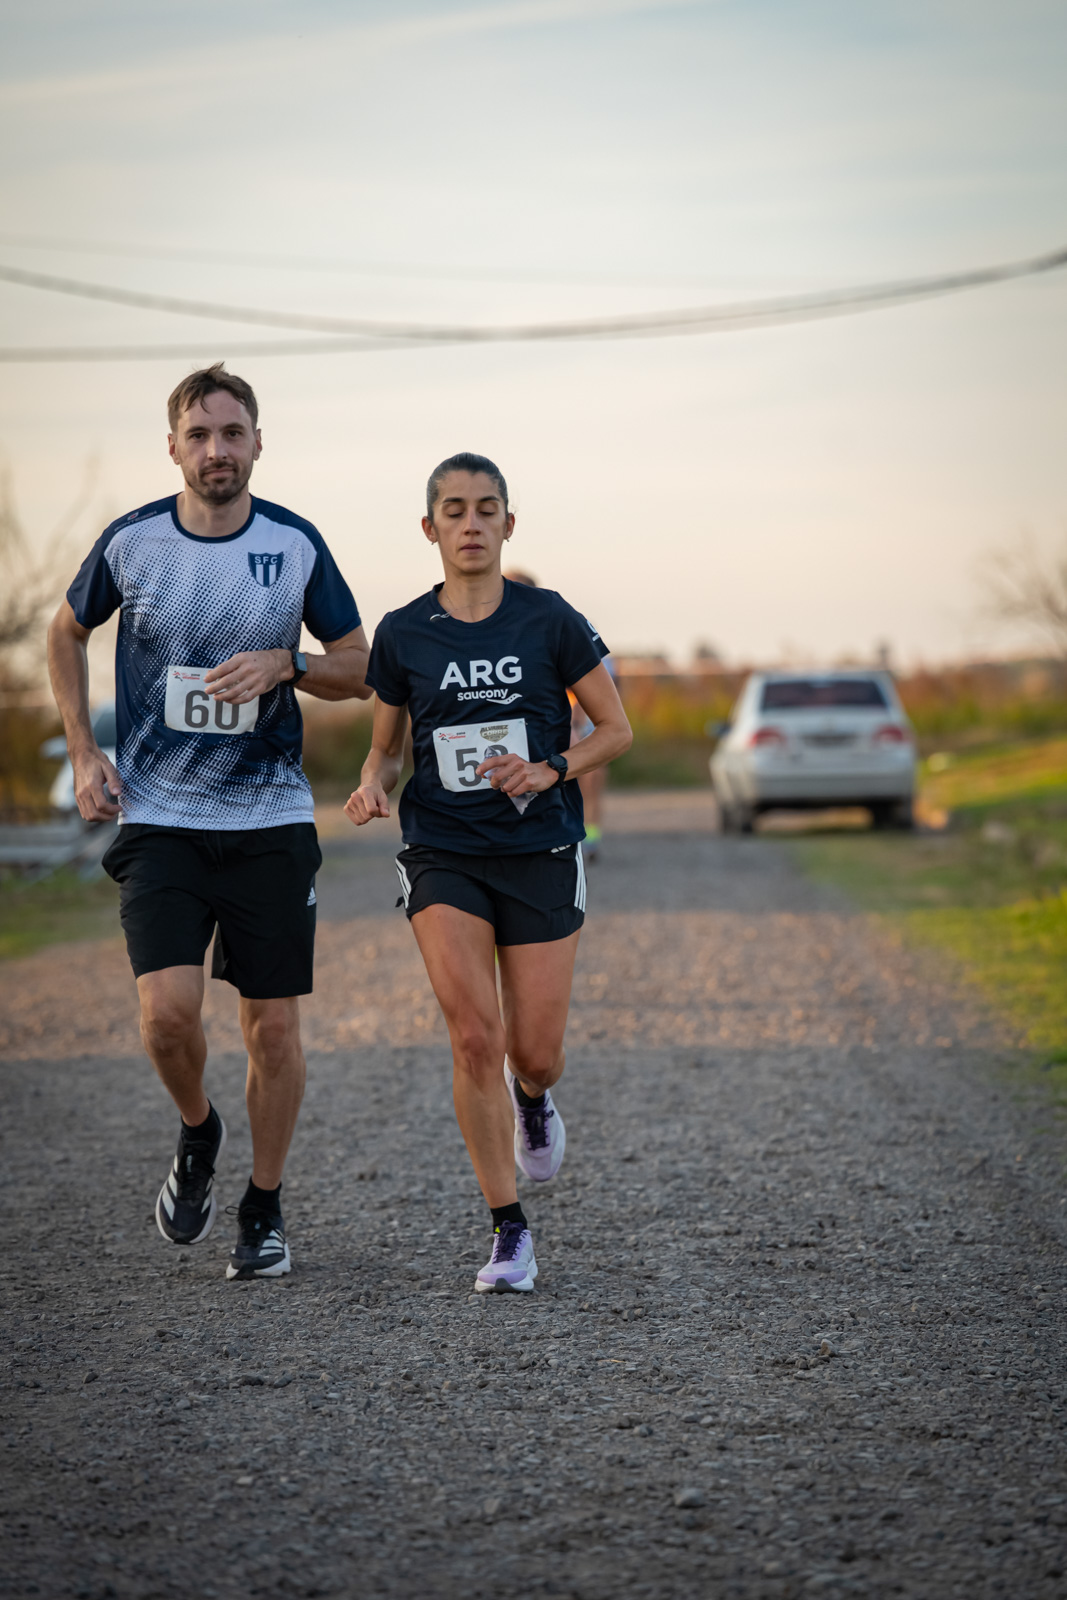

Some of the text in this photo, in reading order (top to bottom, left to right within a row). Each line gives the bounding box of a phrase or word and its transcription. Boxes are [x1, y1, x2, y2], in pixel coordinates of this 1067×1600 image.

[254, 556, 278, 564] SFC
[439, 656, 522, 690] ARG
[457, 688, 508, 701] saucony
[184, 690, 240, 730] 60
